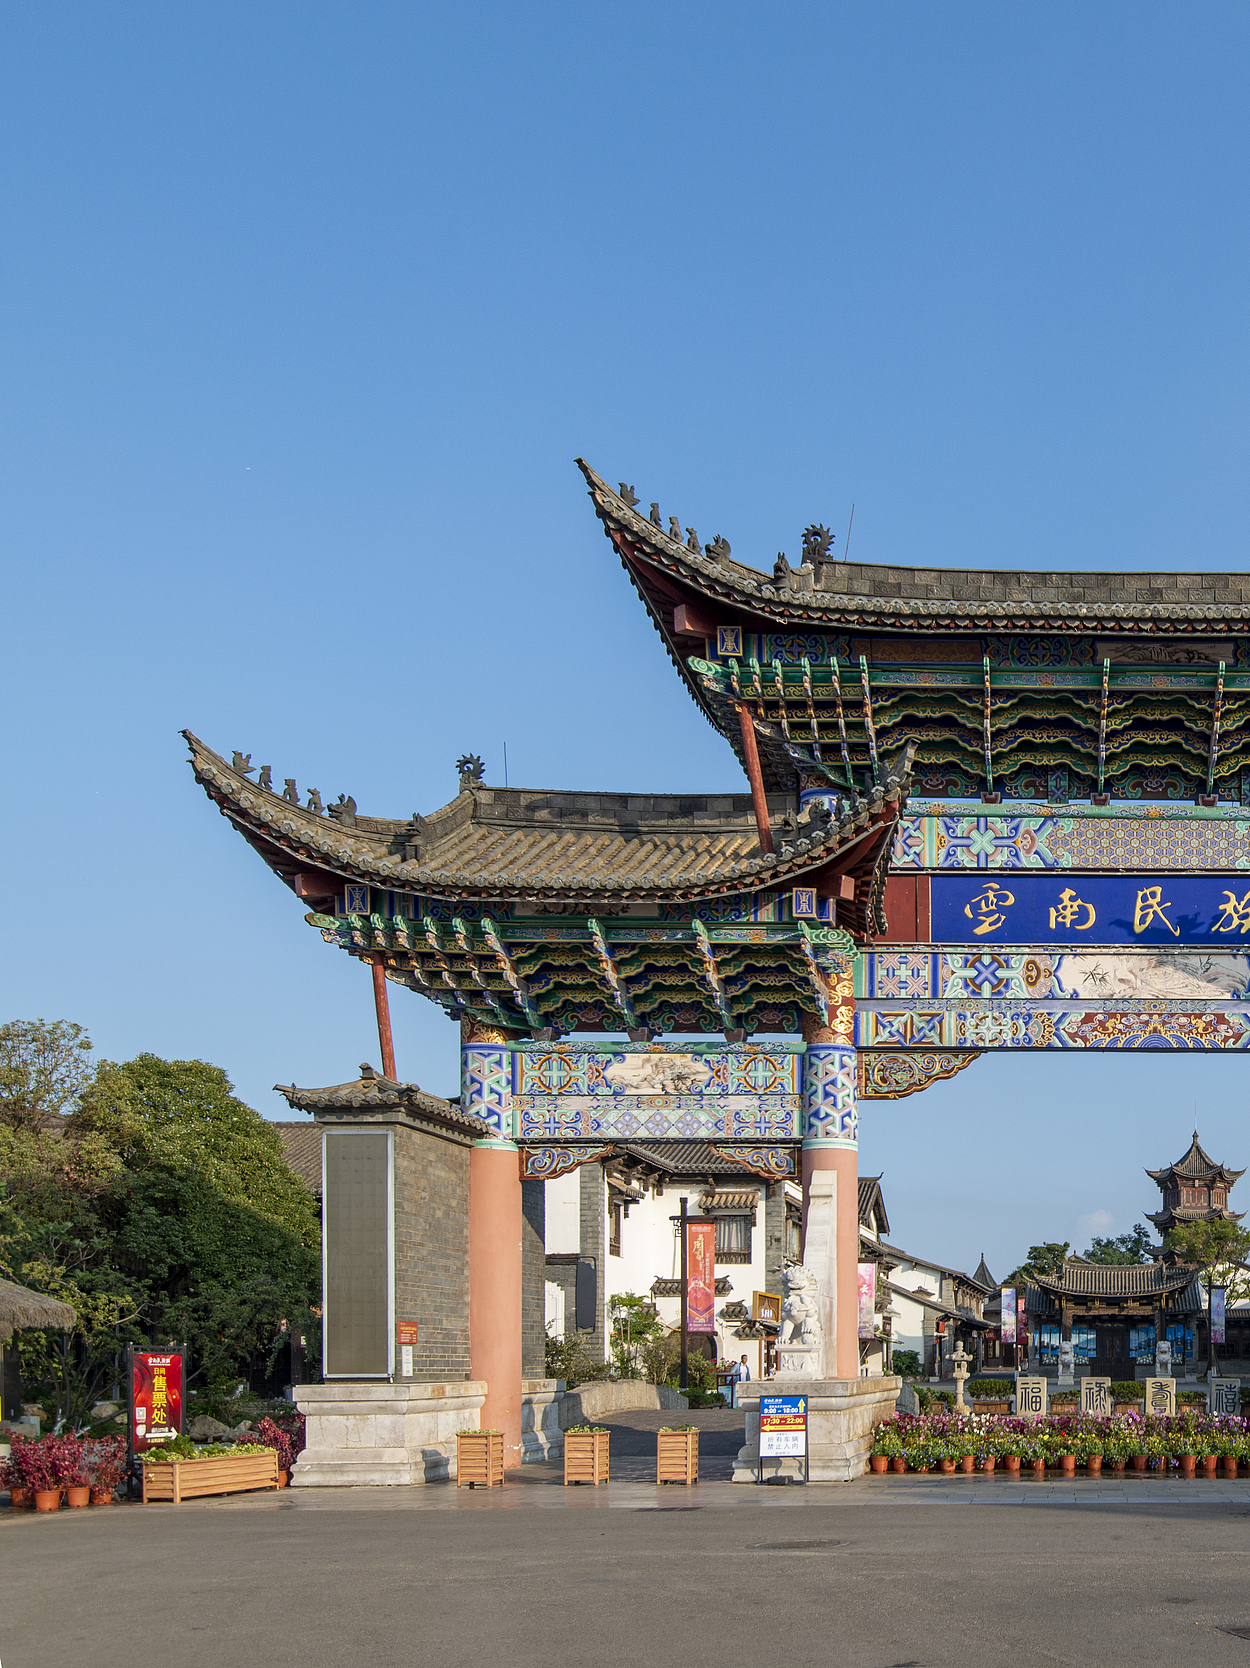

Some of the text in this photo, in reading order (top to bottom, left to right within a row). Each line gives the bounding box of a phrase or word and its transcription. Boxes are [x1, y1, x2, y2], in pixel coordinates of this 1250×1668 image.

[152, 1376, 167, 1424] 售票处
[1019, 1382, 1042, 1412] 福
